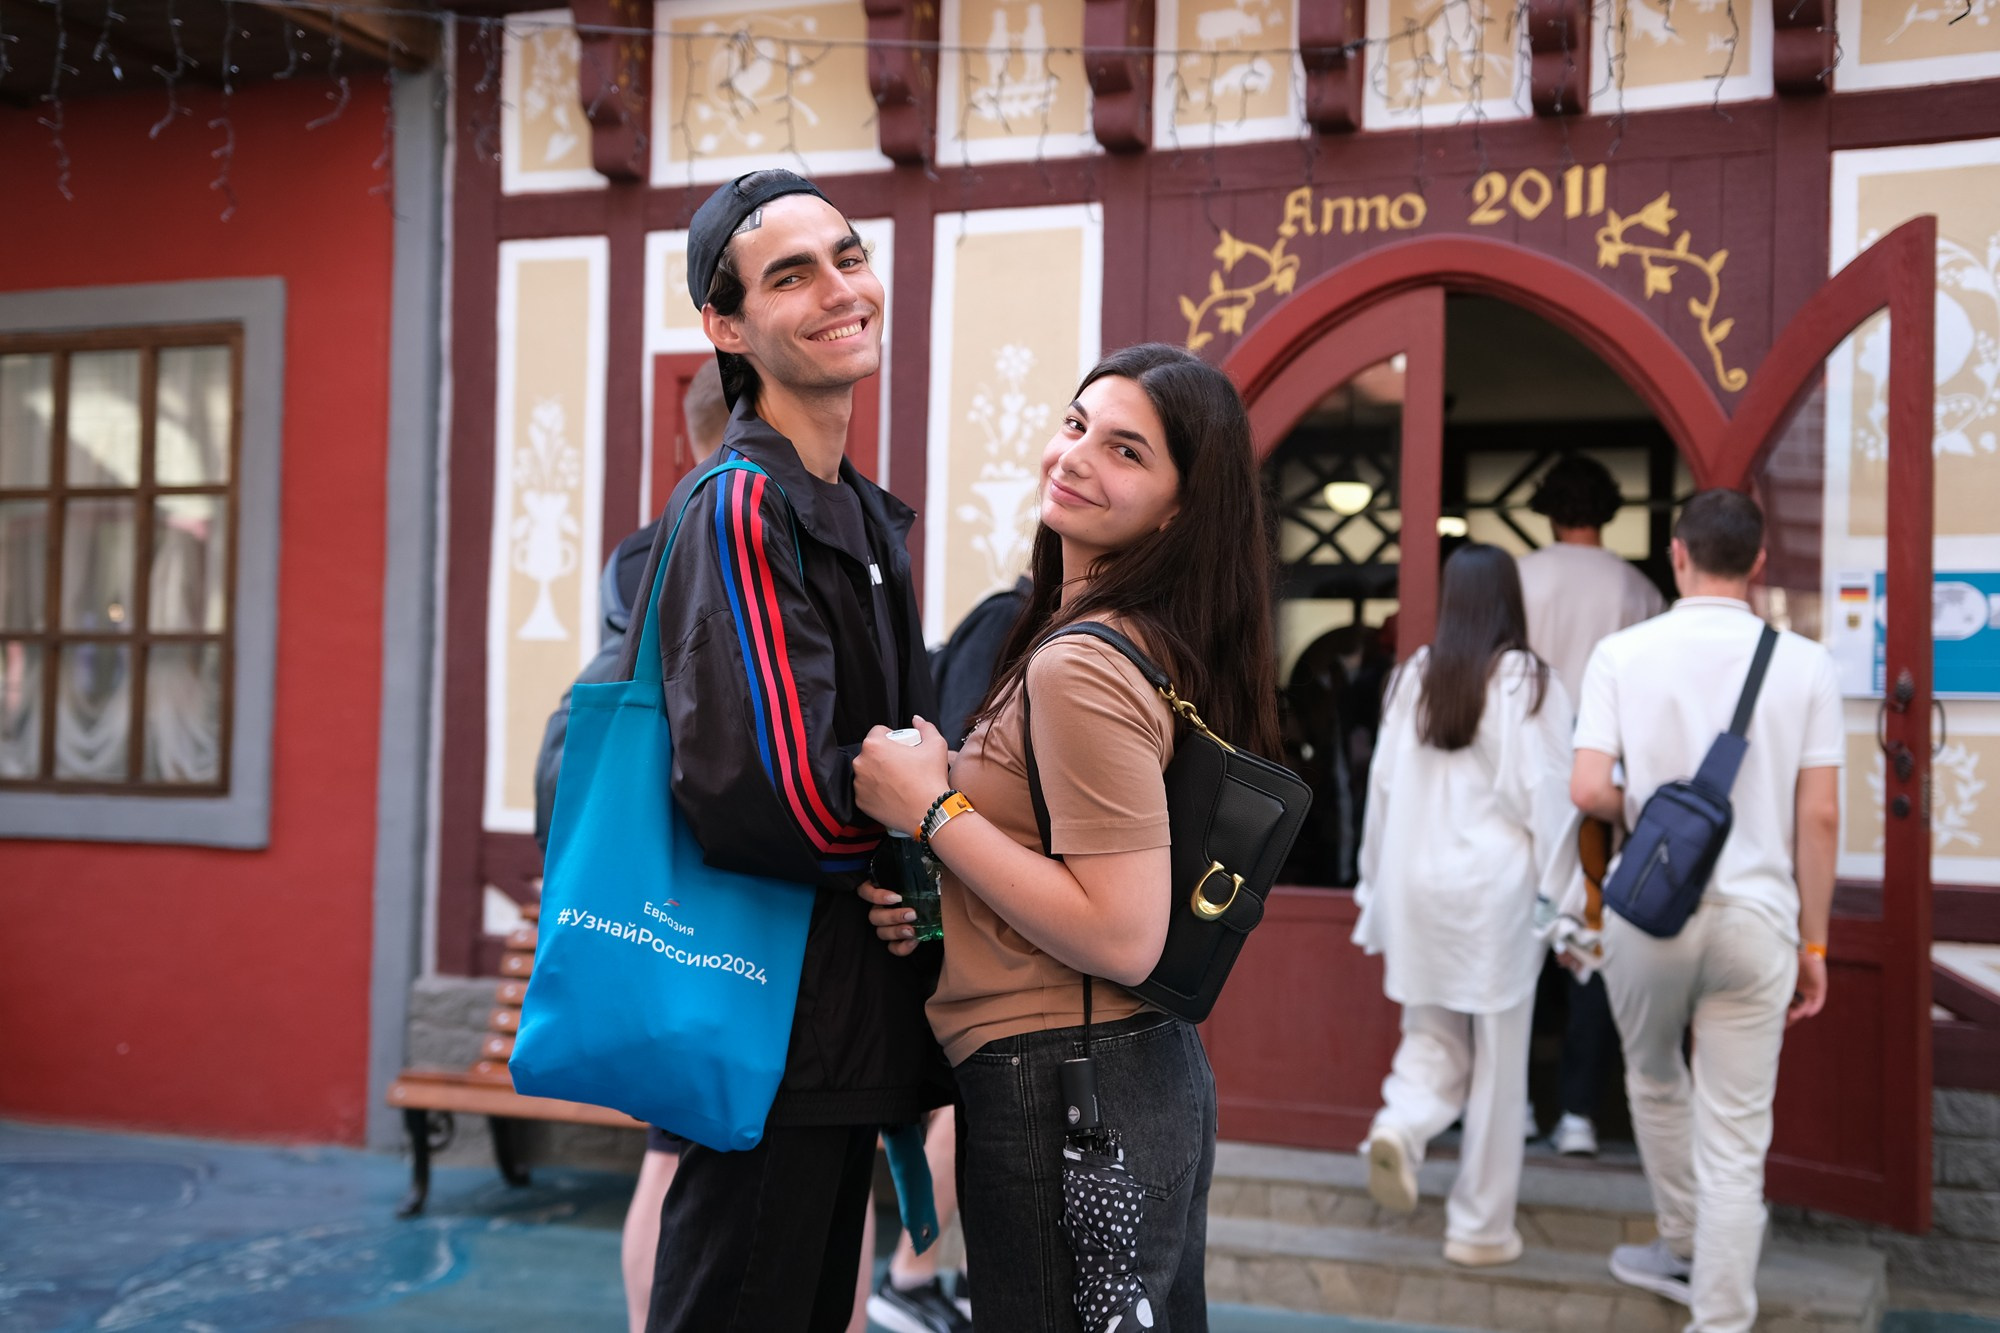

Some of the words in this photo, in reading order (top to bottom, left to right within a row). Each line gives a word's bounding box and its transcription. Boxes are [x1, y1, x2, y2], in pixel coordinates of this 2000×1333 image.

[1278, 186, 1427, 236] Anno
[1468, 164, 1607, 225] 2011
[557, 908, 767, 985] #УзнайРоссию2024
[643, 901, 695, 936] Евразия
